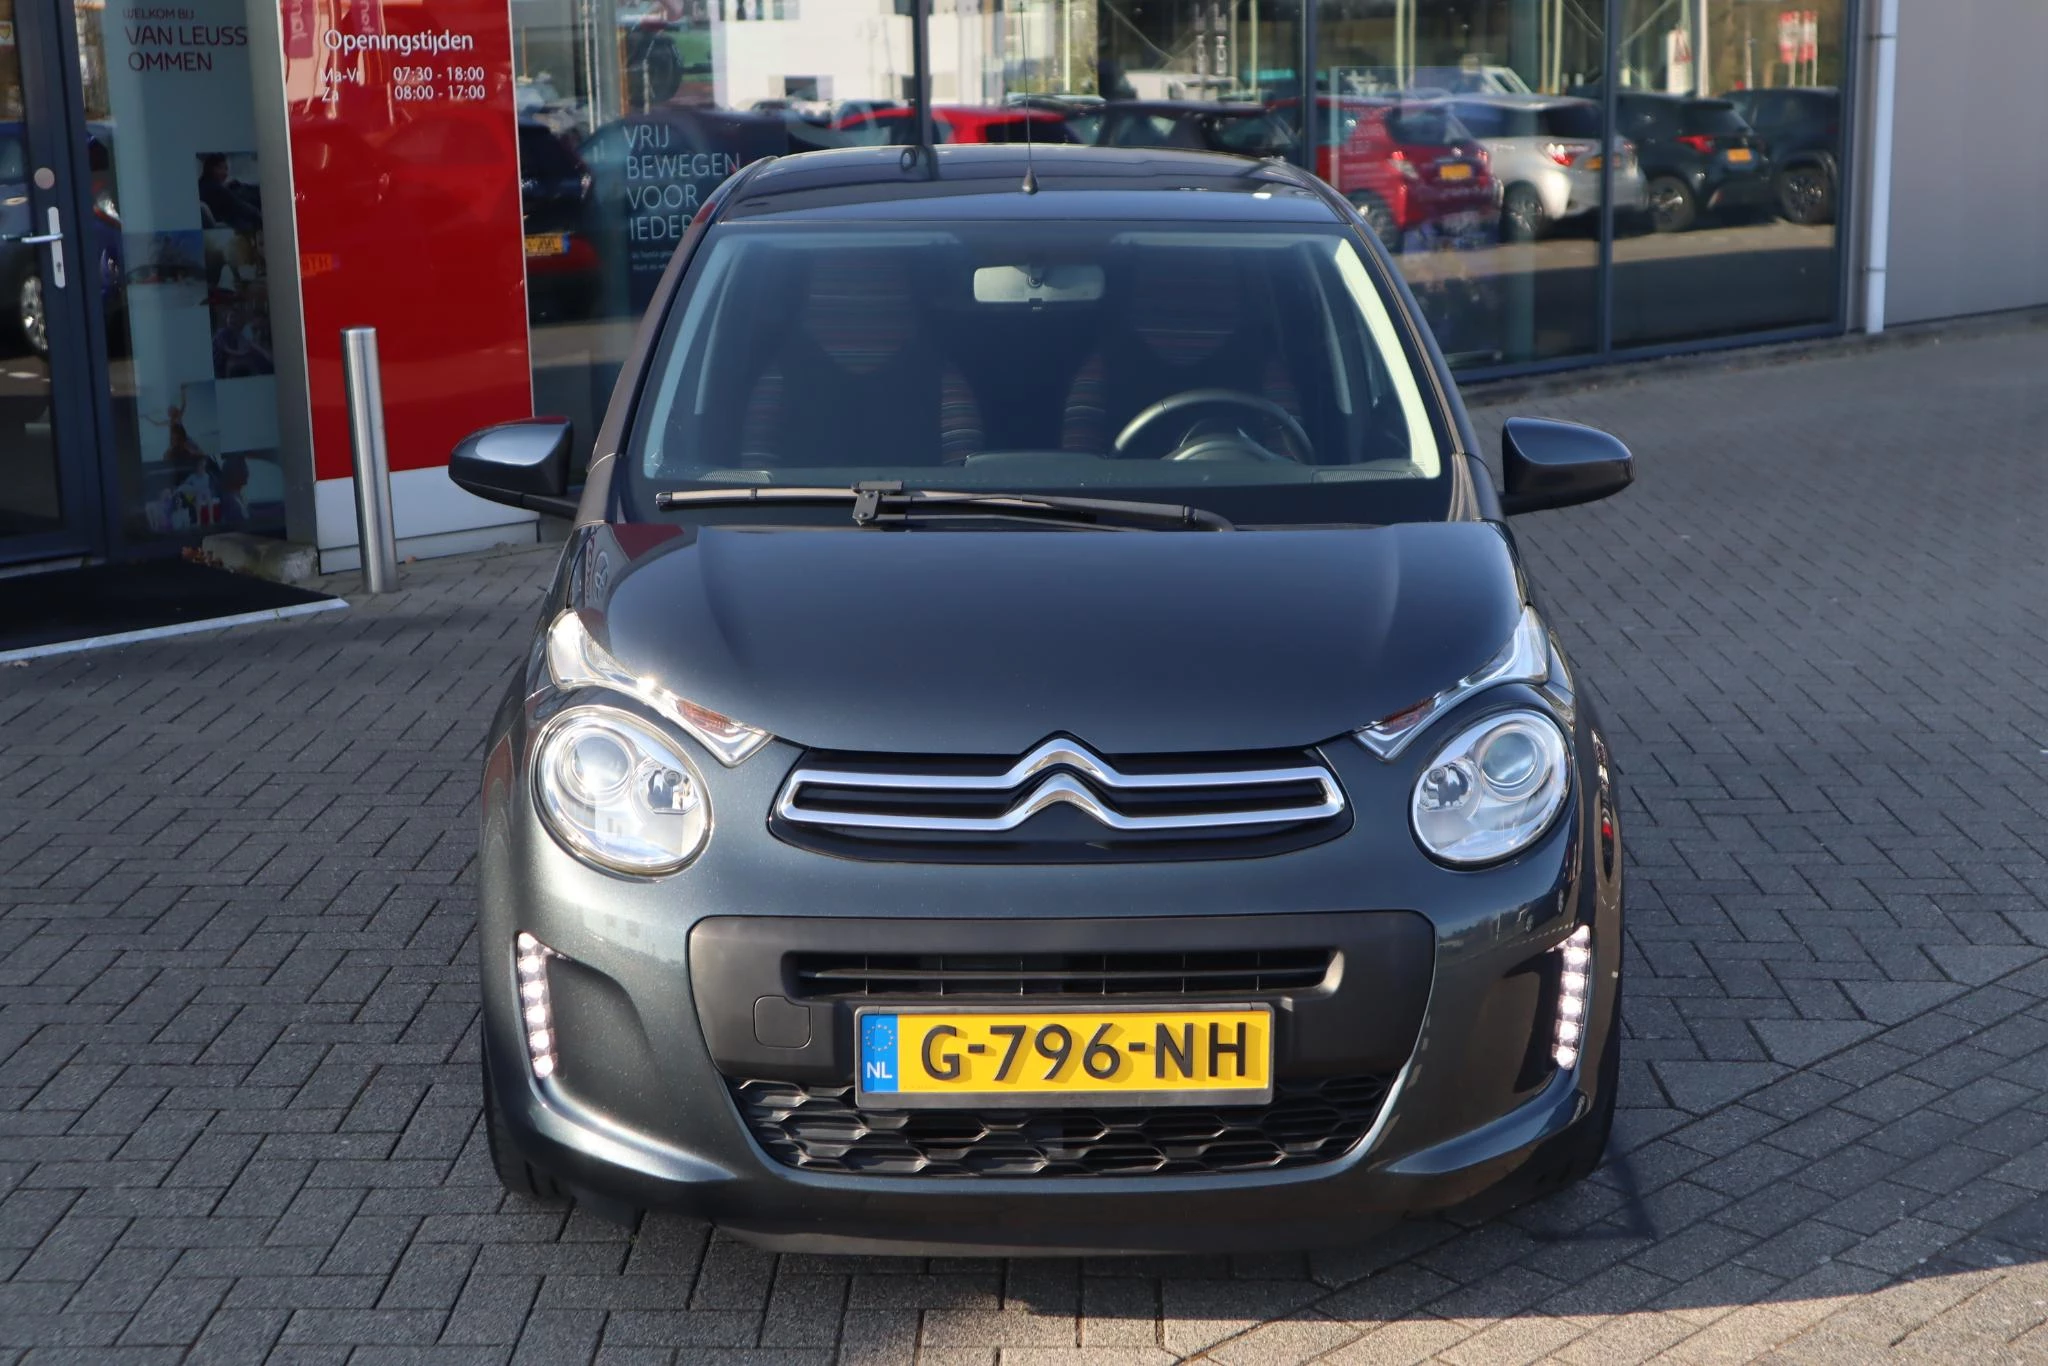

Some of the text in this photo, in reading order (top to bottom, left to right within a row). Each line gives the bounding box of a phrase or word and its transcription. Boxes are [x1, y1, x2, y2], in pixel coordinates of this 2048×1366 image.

[125, 25, 248, 46] VAN LEUSS
[324, 29, 474, 56] Openingstijden
[128, 51, 212, 71] OMMEN
[393, 66, 433, 81] 07:30
[447, 66, 485, 81] 18:00
[322, 87, 340, 102] Za
[394, 85, 434, 100] 08:00
[448, 85, 486, 99] 17:00
[623, 124, 670, 149] VRIJ
[626, 152, 741, 180] BEWEGEN
[626, 184, 699, 210] VOOR
[866, 1022, 1247, 1082] NL G-796-NH
